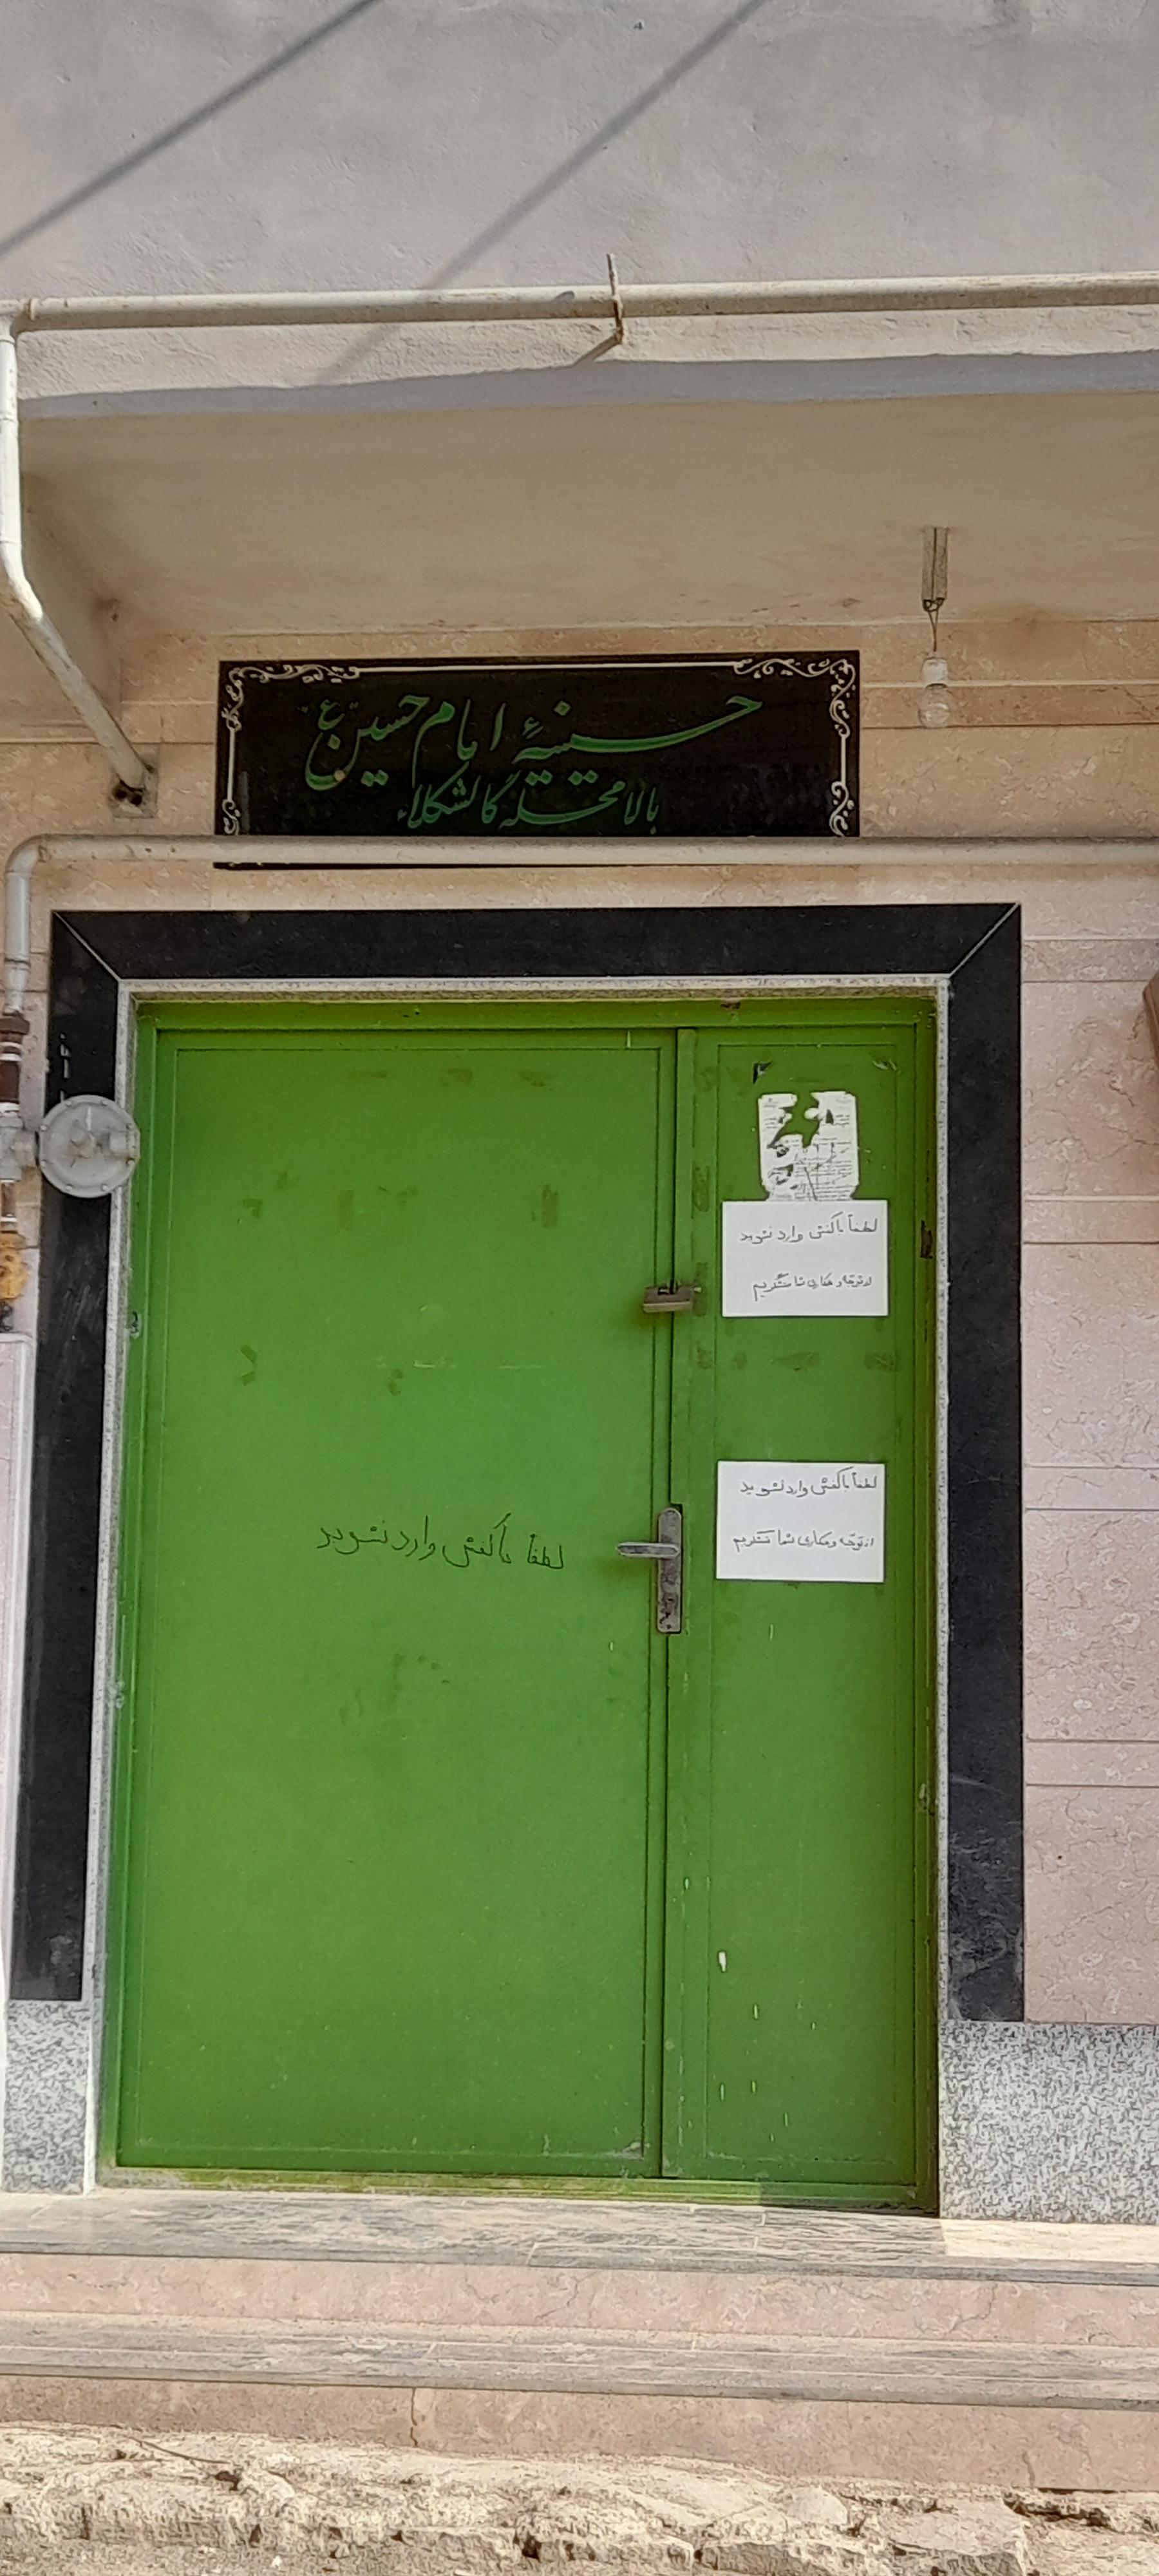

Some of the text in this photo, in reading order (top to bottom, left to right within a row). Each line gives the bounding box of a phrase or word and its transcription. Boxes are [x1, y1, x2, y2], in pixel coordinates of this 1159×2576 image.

[305, 694, 431, 791] حسین
[411, 697, 507, 789] امام
[740, 1226, 773, 1245] نشوید
[777, 1225, 804, 1243] وارد
[793, 1274, 806, 1287] شما
[786, 1480, 808, 1498] وارد
[316, 1519, 388, 1555] نشوید
[391, 1514, 436, 1561] وارد
[778, 1528, 795, 1546] شما
